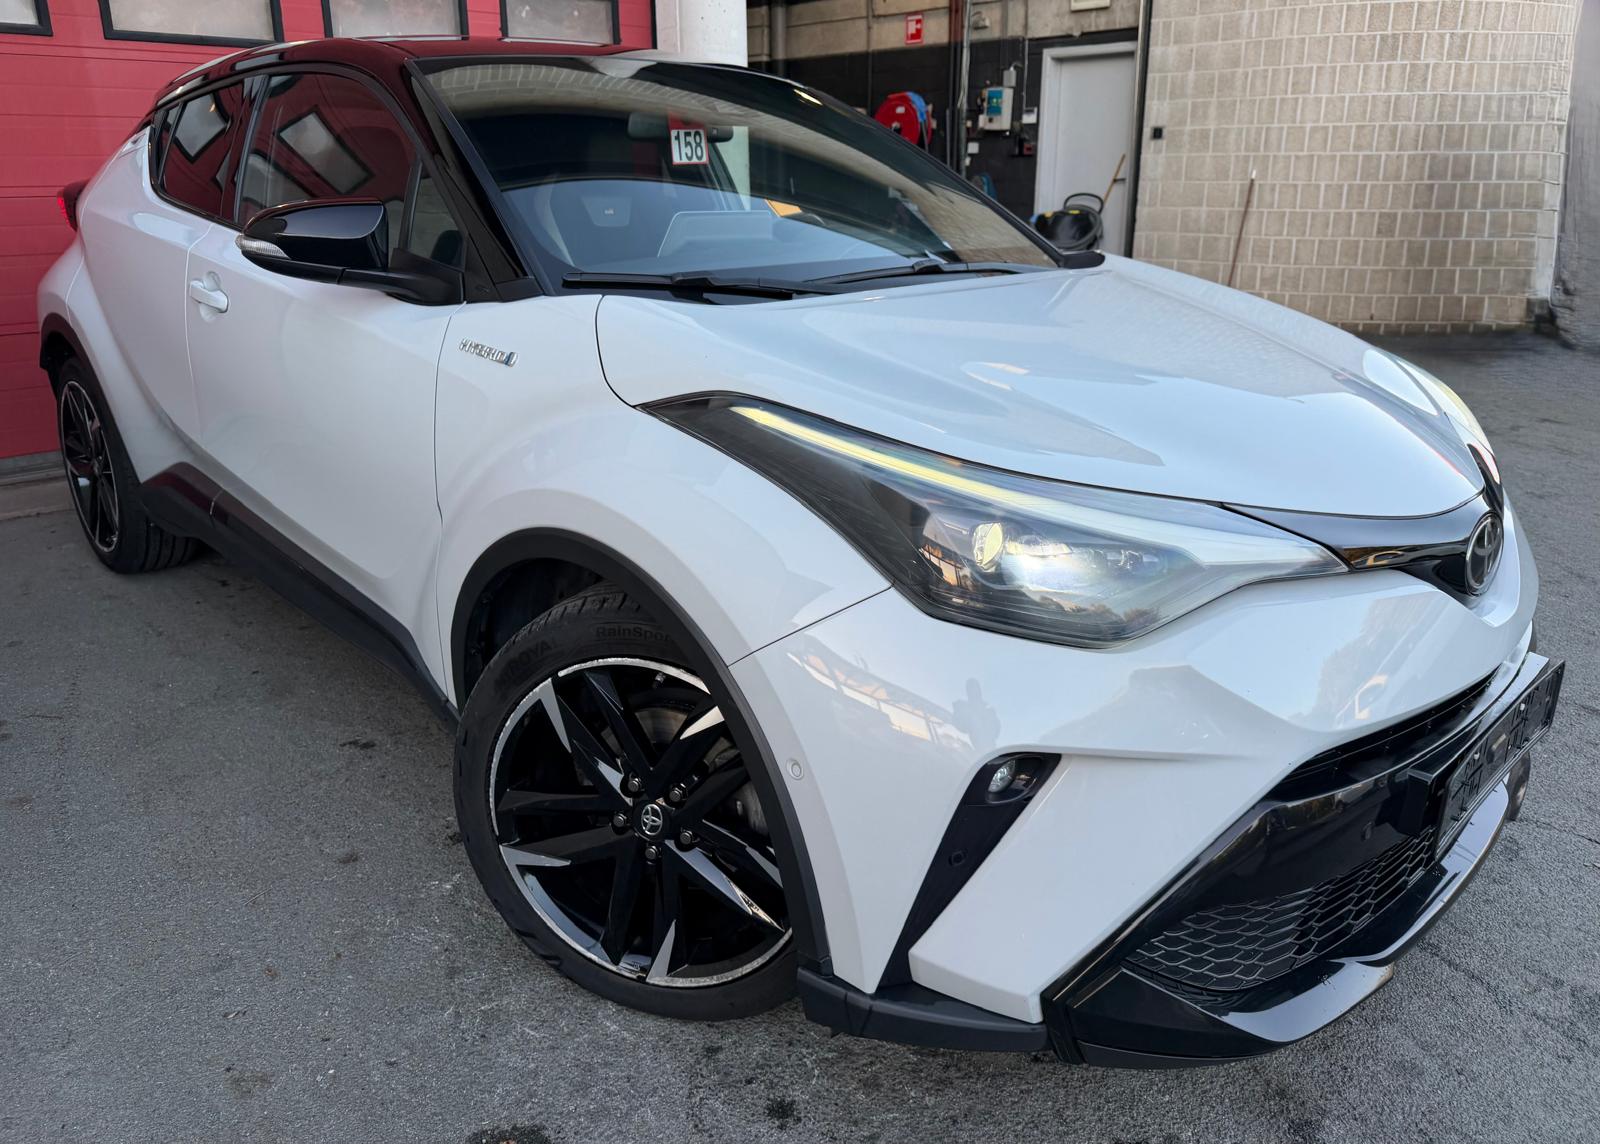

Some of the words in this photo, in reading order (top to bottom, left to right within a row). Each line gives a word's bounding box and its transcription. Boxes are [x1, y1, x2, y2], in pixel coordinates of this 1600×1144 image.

[674, 130, 704, 161] 158
[460, 338, 518, 367] HYBRID
[596, 626, 672, 641] RainSpor
